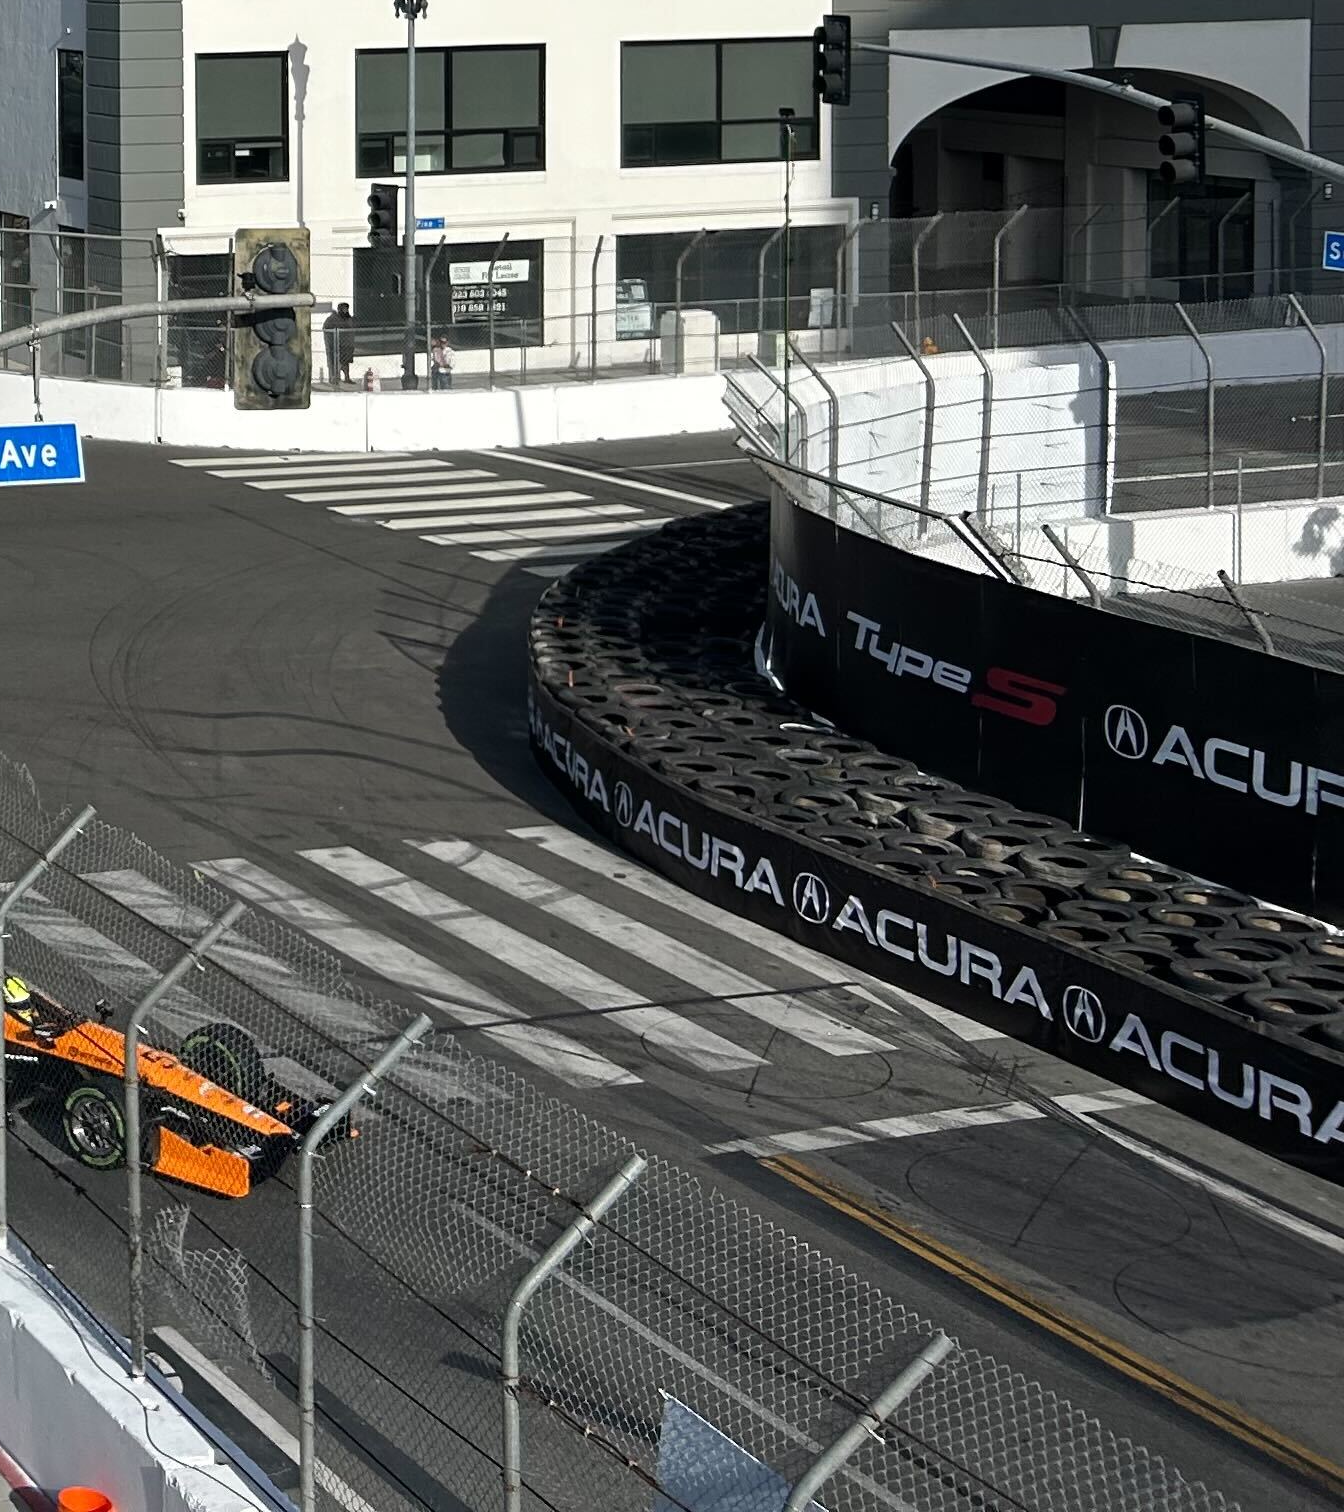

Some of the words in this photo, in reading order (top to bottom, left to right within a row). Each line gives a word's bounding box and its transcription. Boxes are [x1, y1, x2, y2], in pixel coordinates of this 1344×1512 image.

[0, 439, 57, 470] Ave
[846, 610, 972, 693] Type
[971, 667, 1067, 726] S
[543, 721, 611, 813] ACURA
[633, 799, 786, 907] ACURA
[832, 894, 1054, 1022] ACURA
